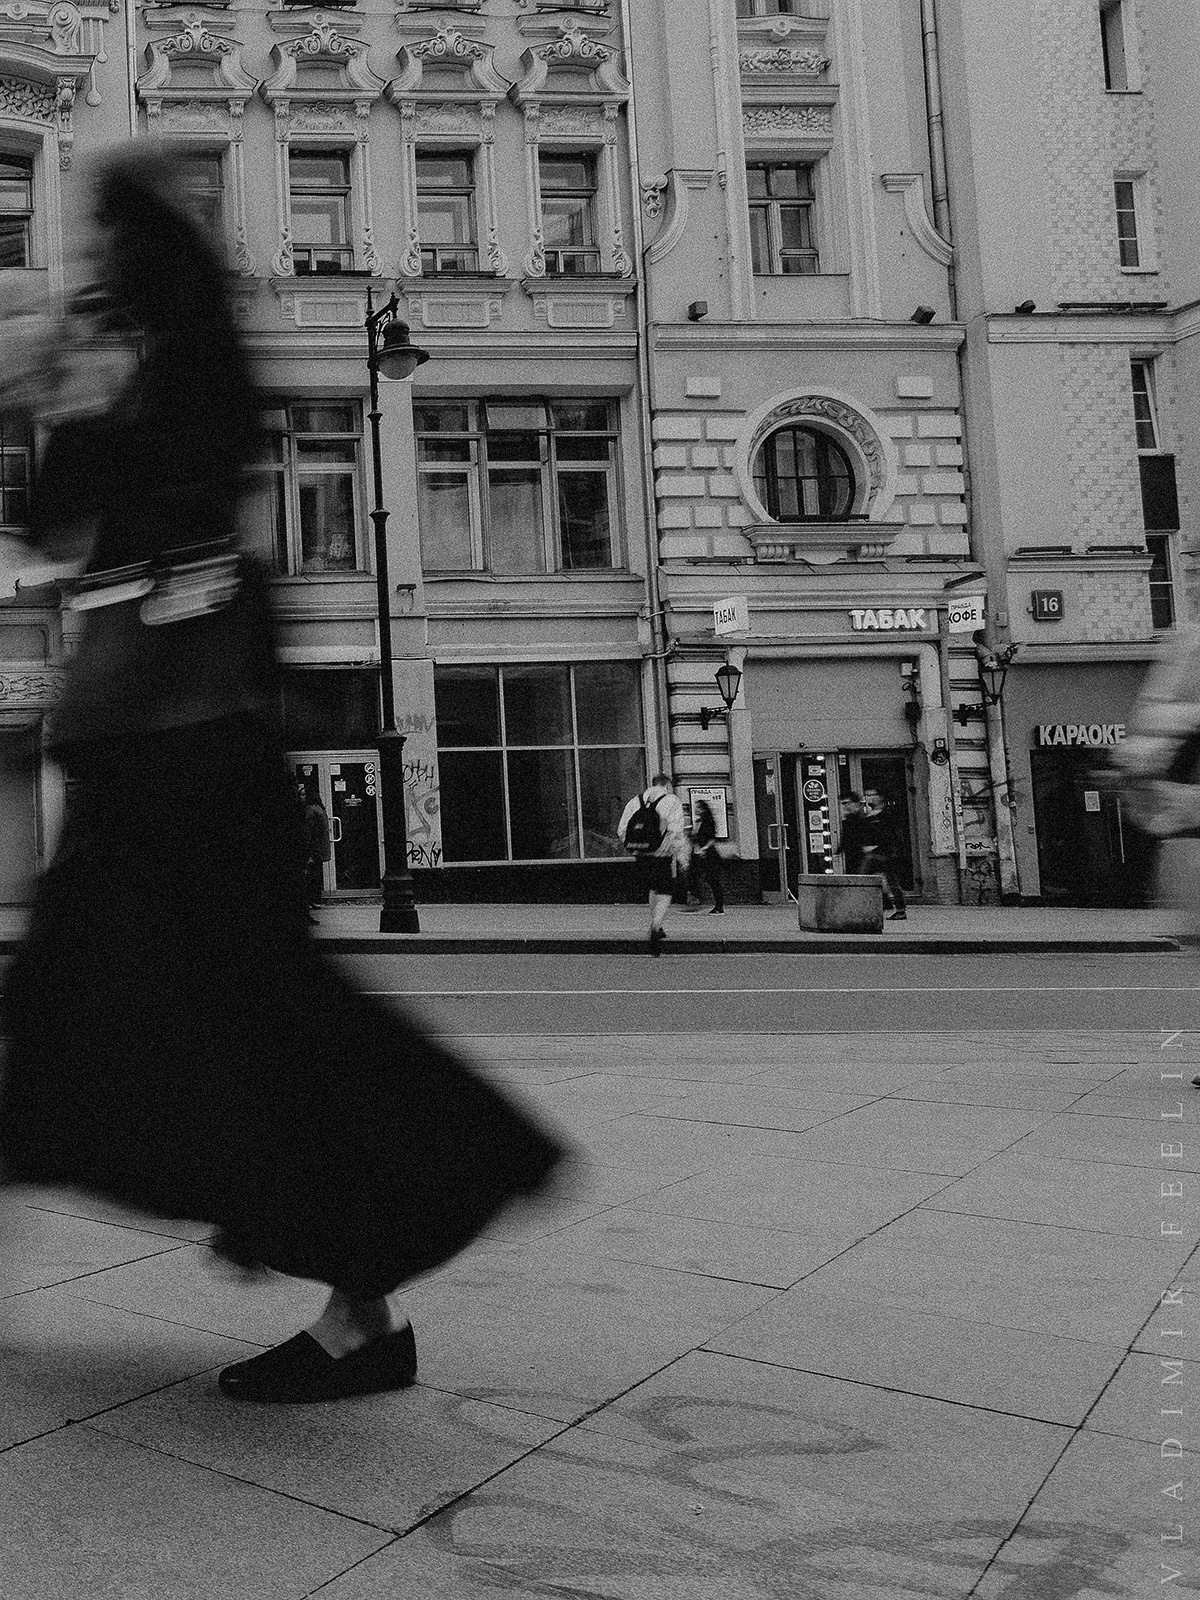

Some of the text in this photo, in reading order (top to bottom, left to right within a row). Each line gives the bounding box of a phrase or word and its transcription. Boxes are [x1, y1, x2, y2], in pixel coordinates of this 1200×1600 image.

[1041, 597, 1059, 612] 16
[715, 606, 736, 625] ТАБАК
[850, 608, 927, 630] ТАБАК
[949, 609, 977, 624] КОФЕ
[1039, 724, 1126, 746] КАРАОКЕ
